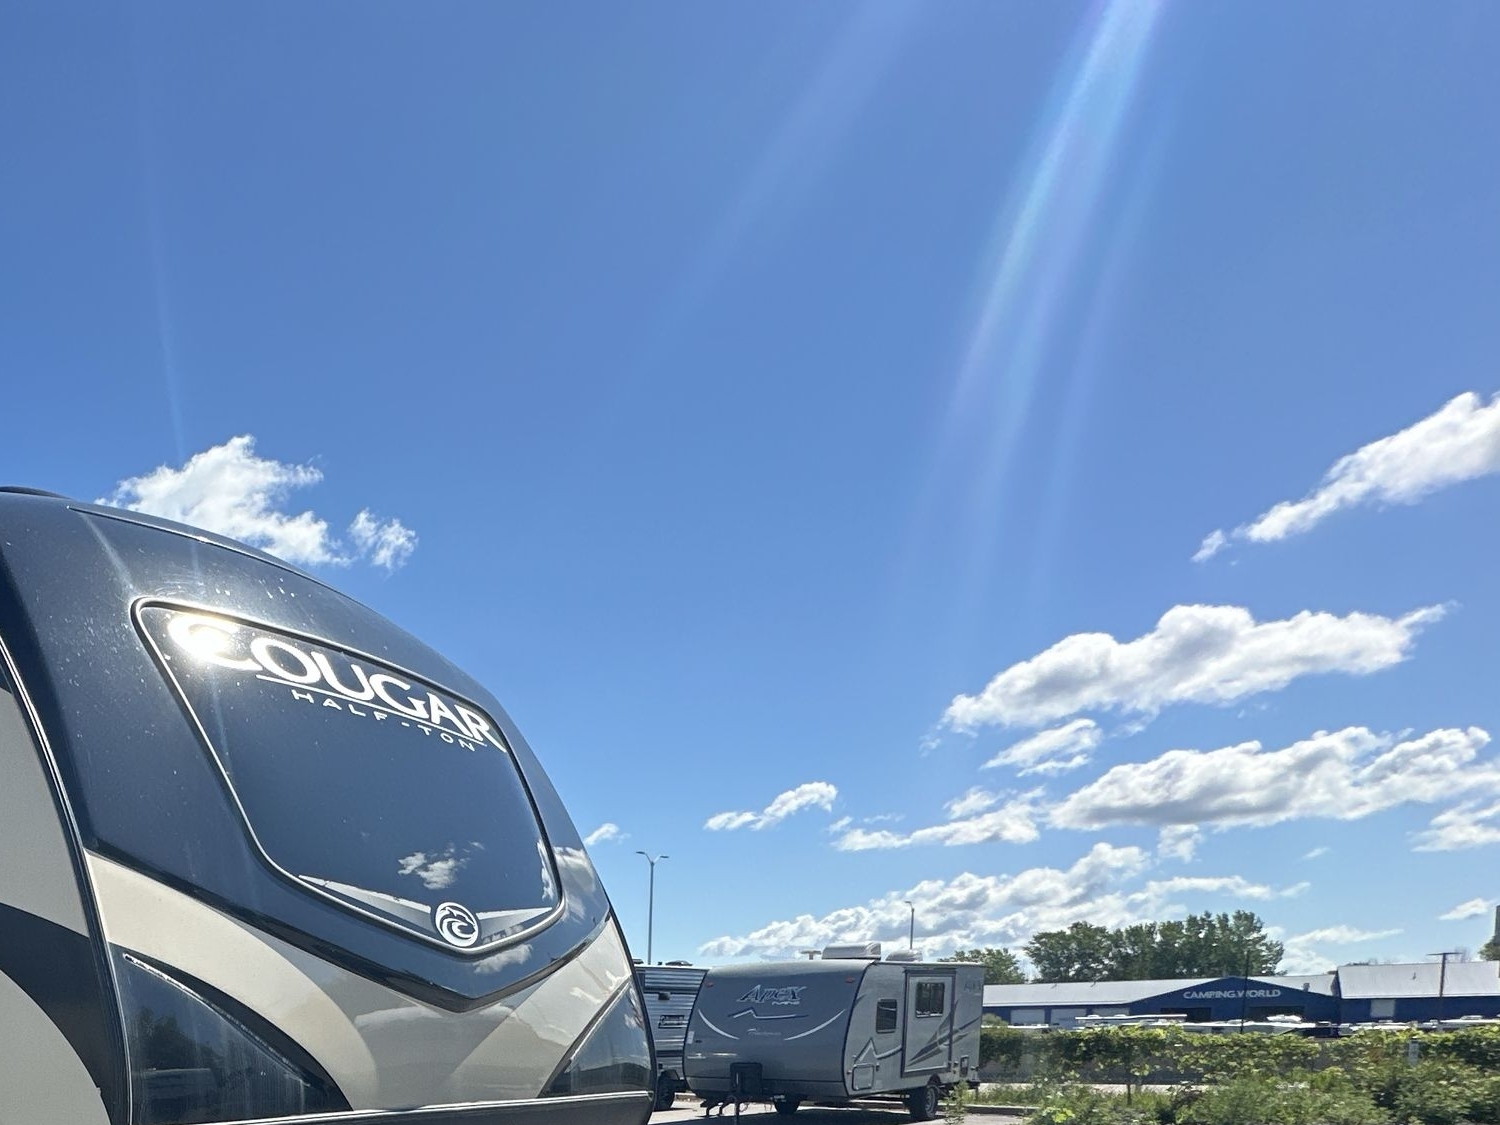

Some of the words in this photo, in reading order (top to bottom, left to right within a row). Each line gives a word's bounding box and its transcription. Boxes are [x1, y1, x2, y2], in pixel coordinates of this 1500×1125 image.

[292, 689, 476, 752] HALF-TON
[1183, 990, 1235, 999] CAMPING
[1237, 989, 1281, 998] WORLD
